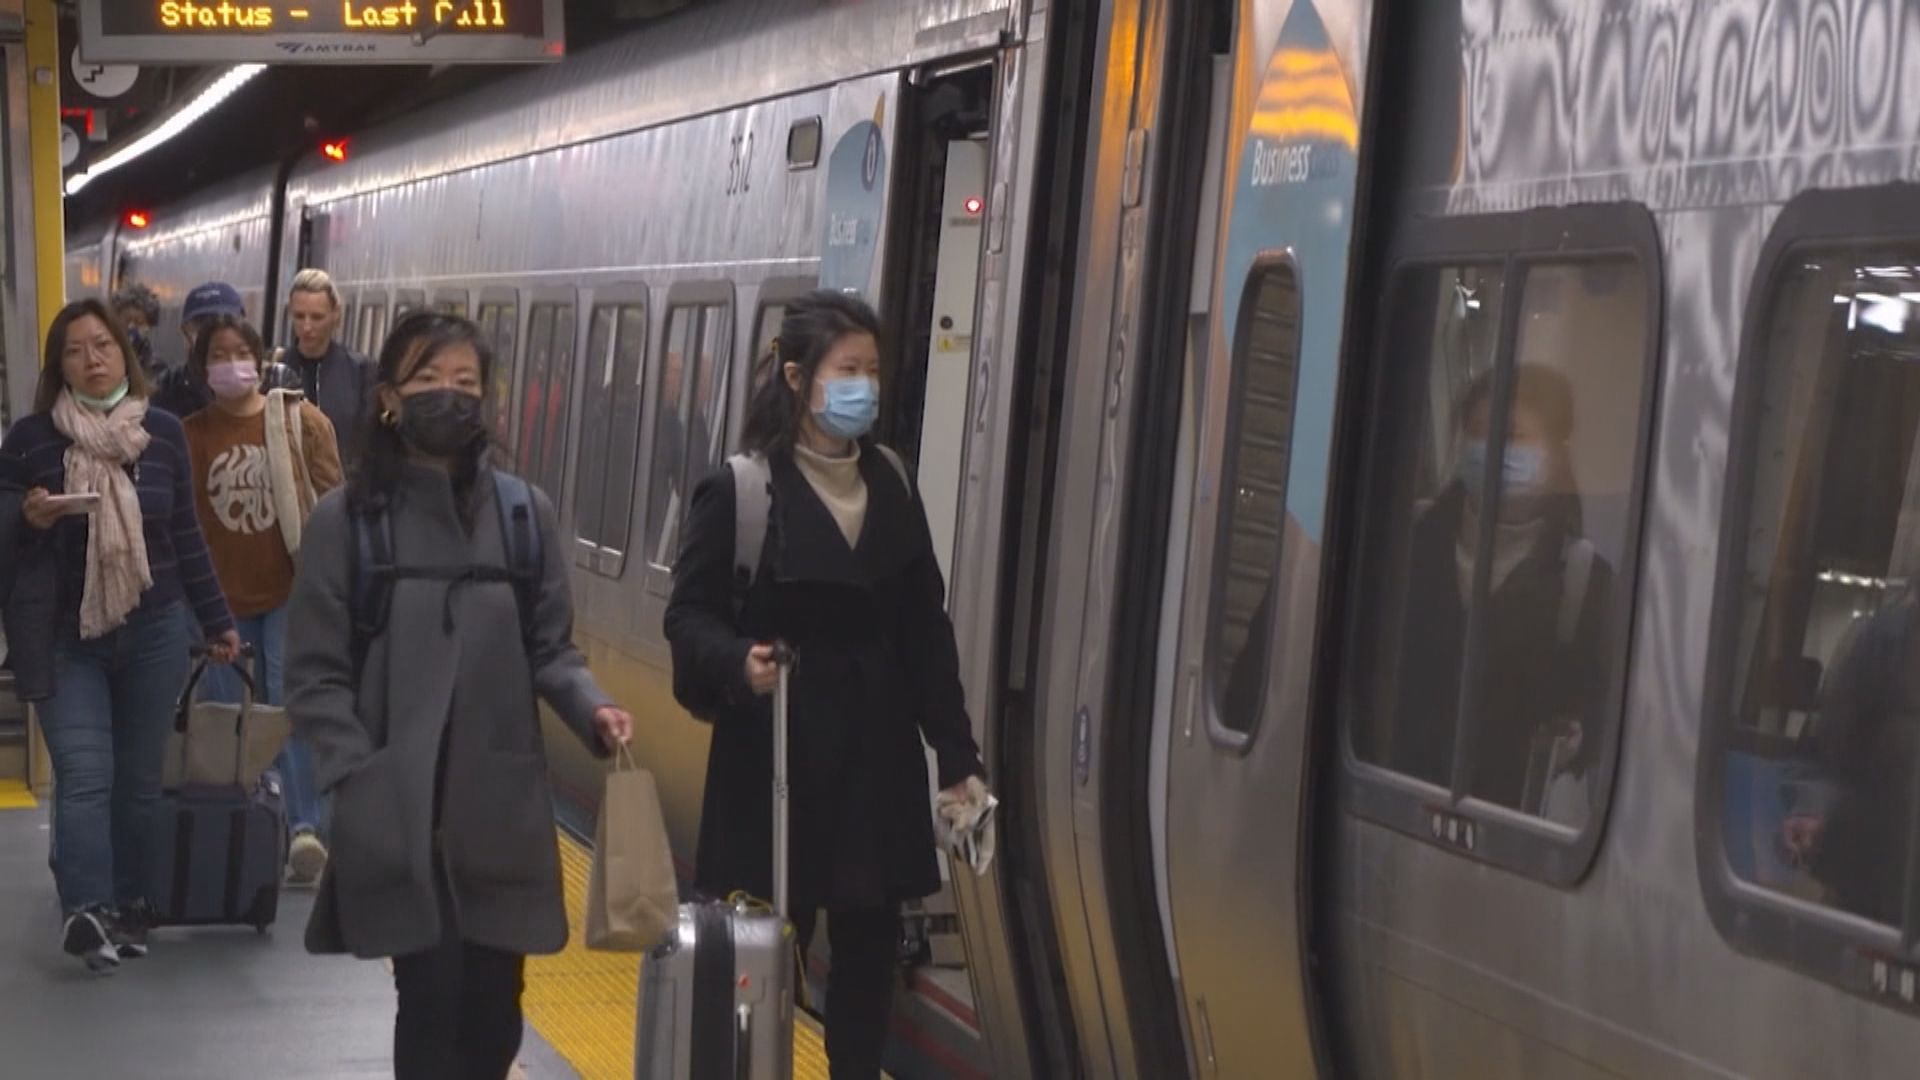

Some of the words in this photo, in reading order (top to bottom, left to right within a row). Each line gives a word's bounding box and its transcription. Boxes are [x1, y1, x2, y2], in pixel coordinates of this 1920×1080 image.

[160, 1, 273, 27] Status
[344, 0, 417, 26] Last
[726, 131, 754, 196] 3512
[1251, 135, 1312, 187] Business
